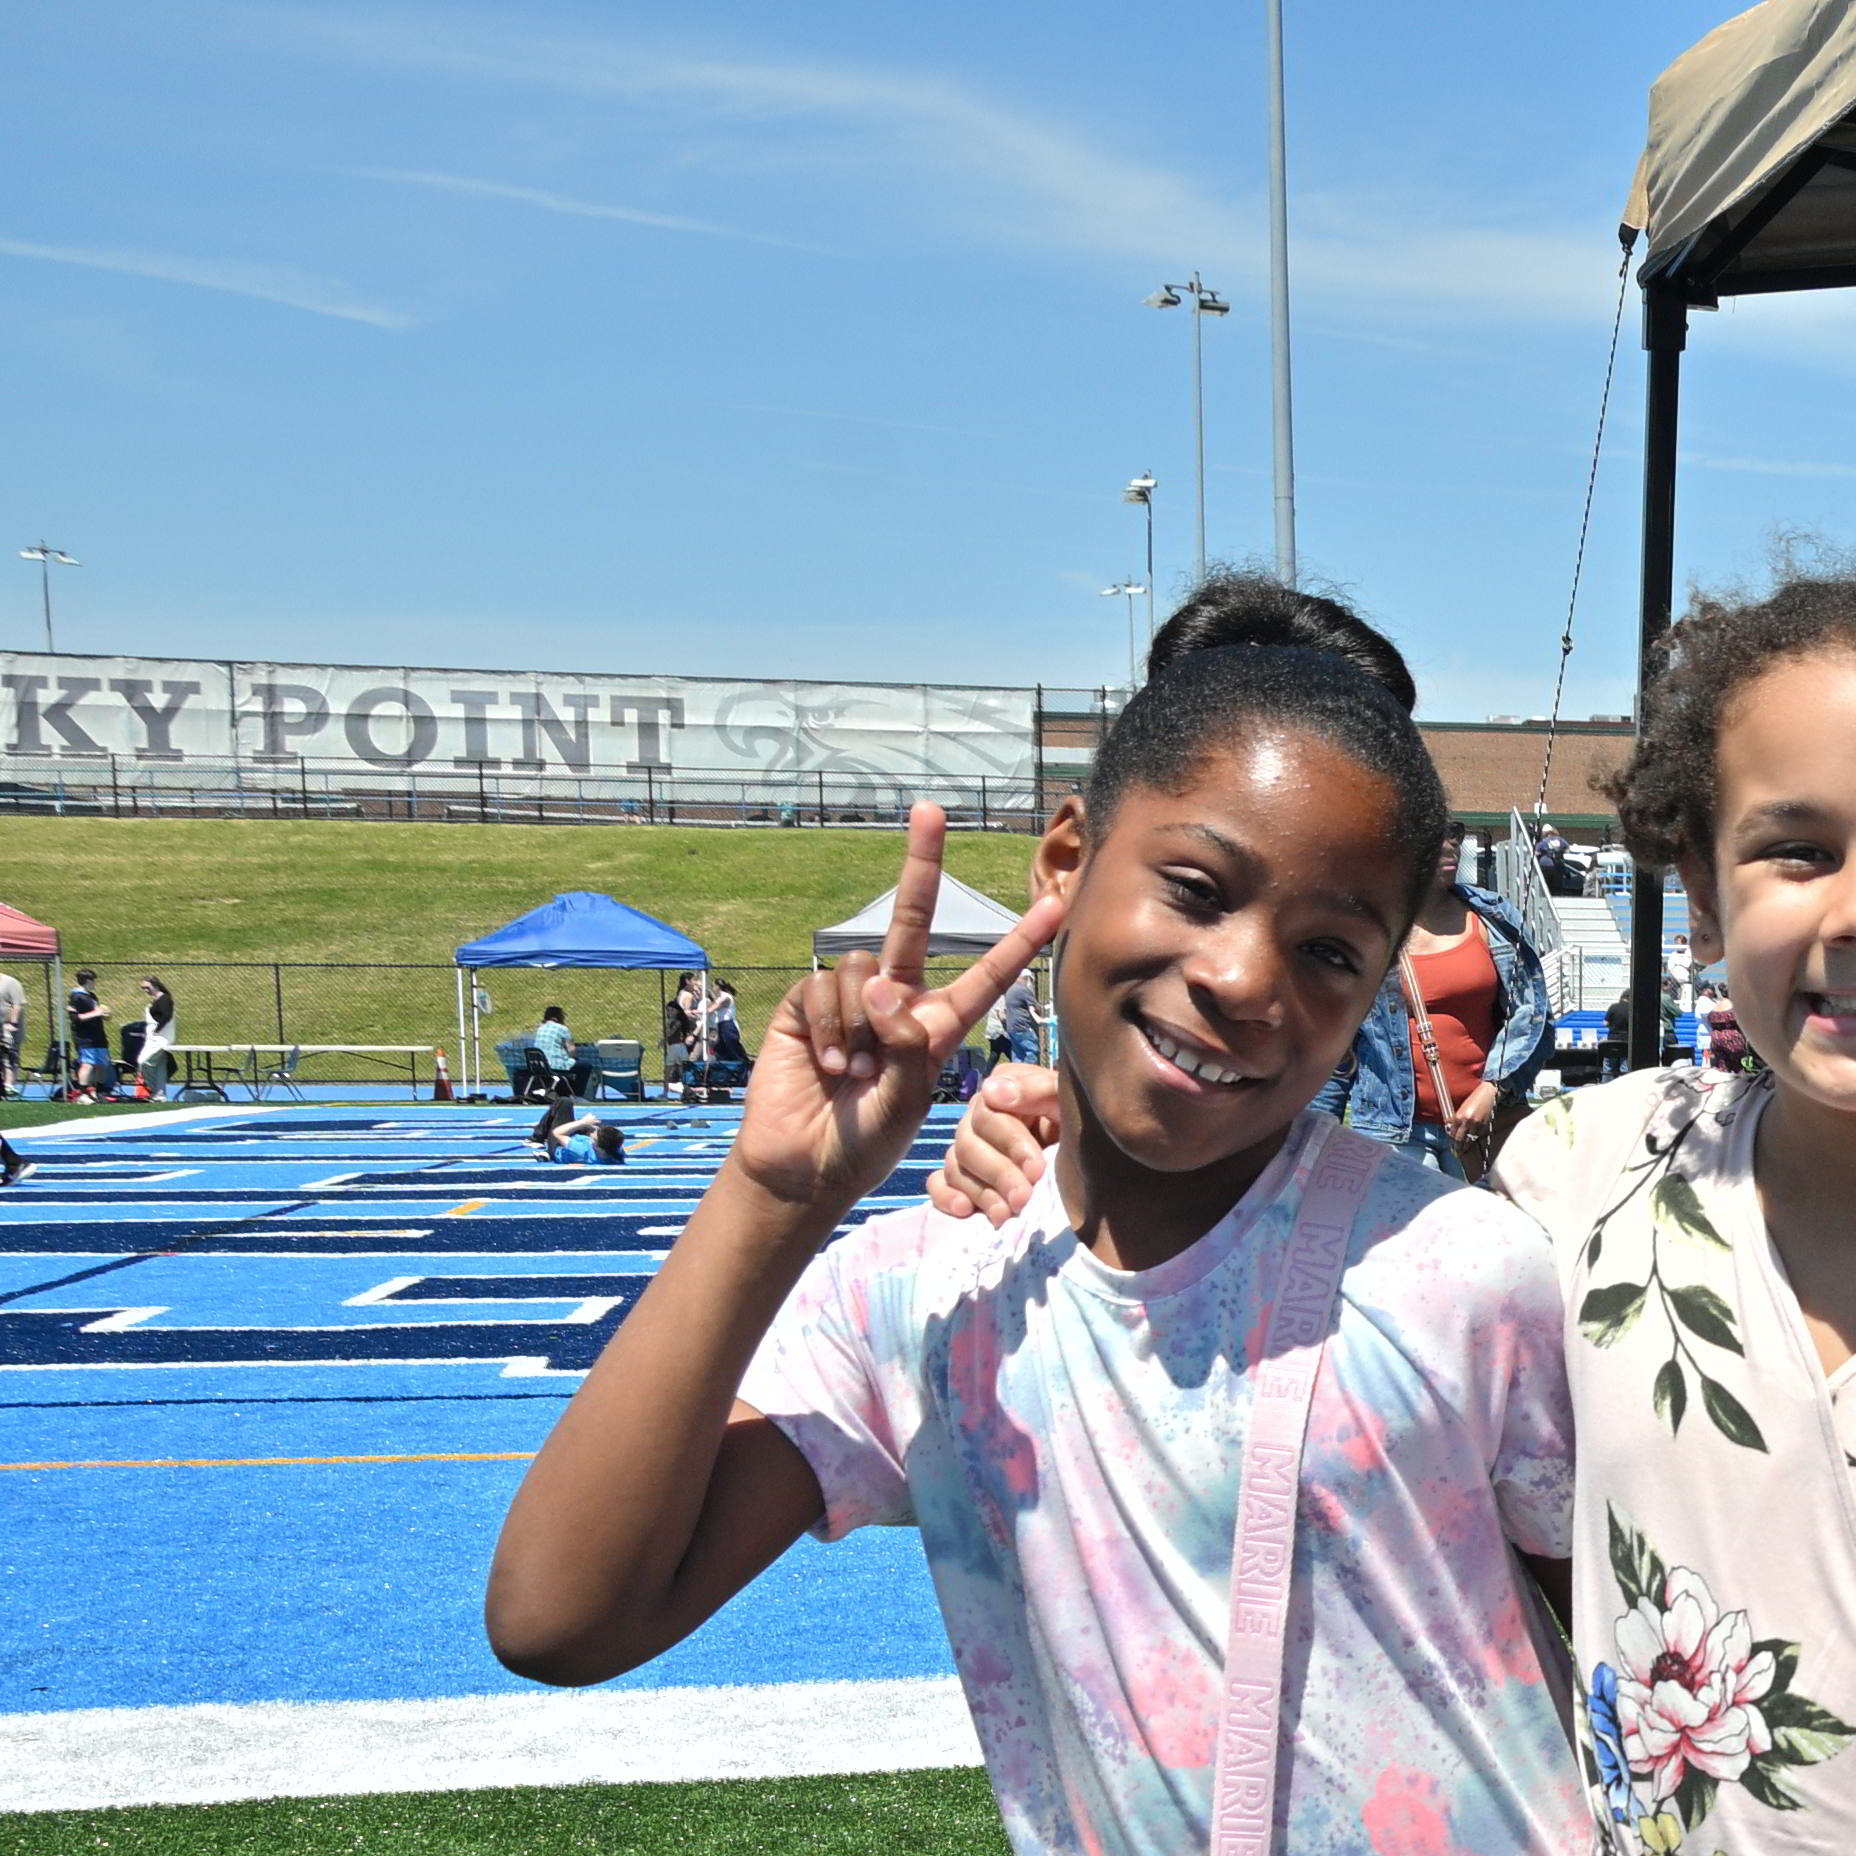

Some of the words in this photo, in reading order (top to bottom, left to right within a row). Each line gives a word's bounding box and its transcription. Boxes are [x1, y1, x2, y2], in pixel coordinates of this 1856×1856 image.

[250, 681, 686, 778] POINT
[1261, 1218, 1347, 1400] MARIE
[1235, 1445, 1297, 1638] MARIE
